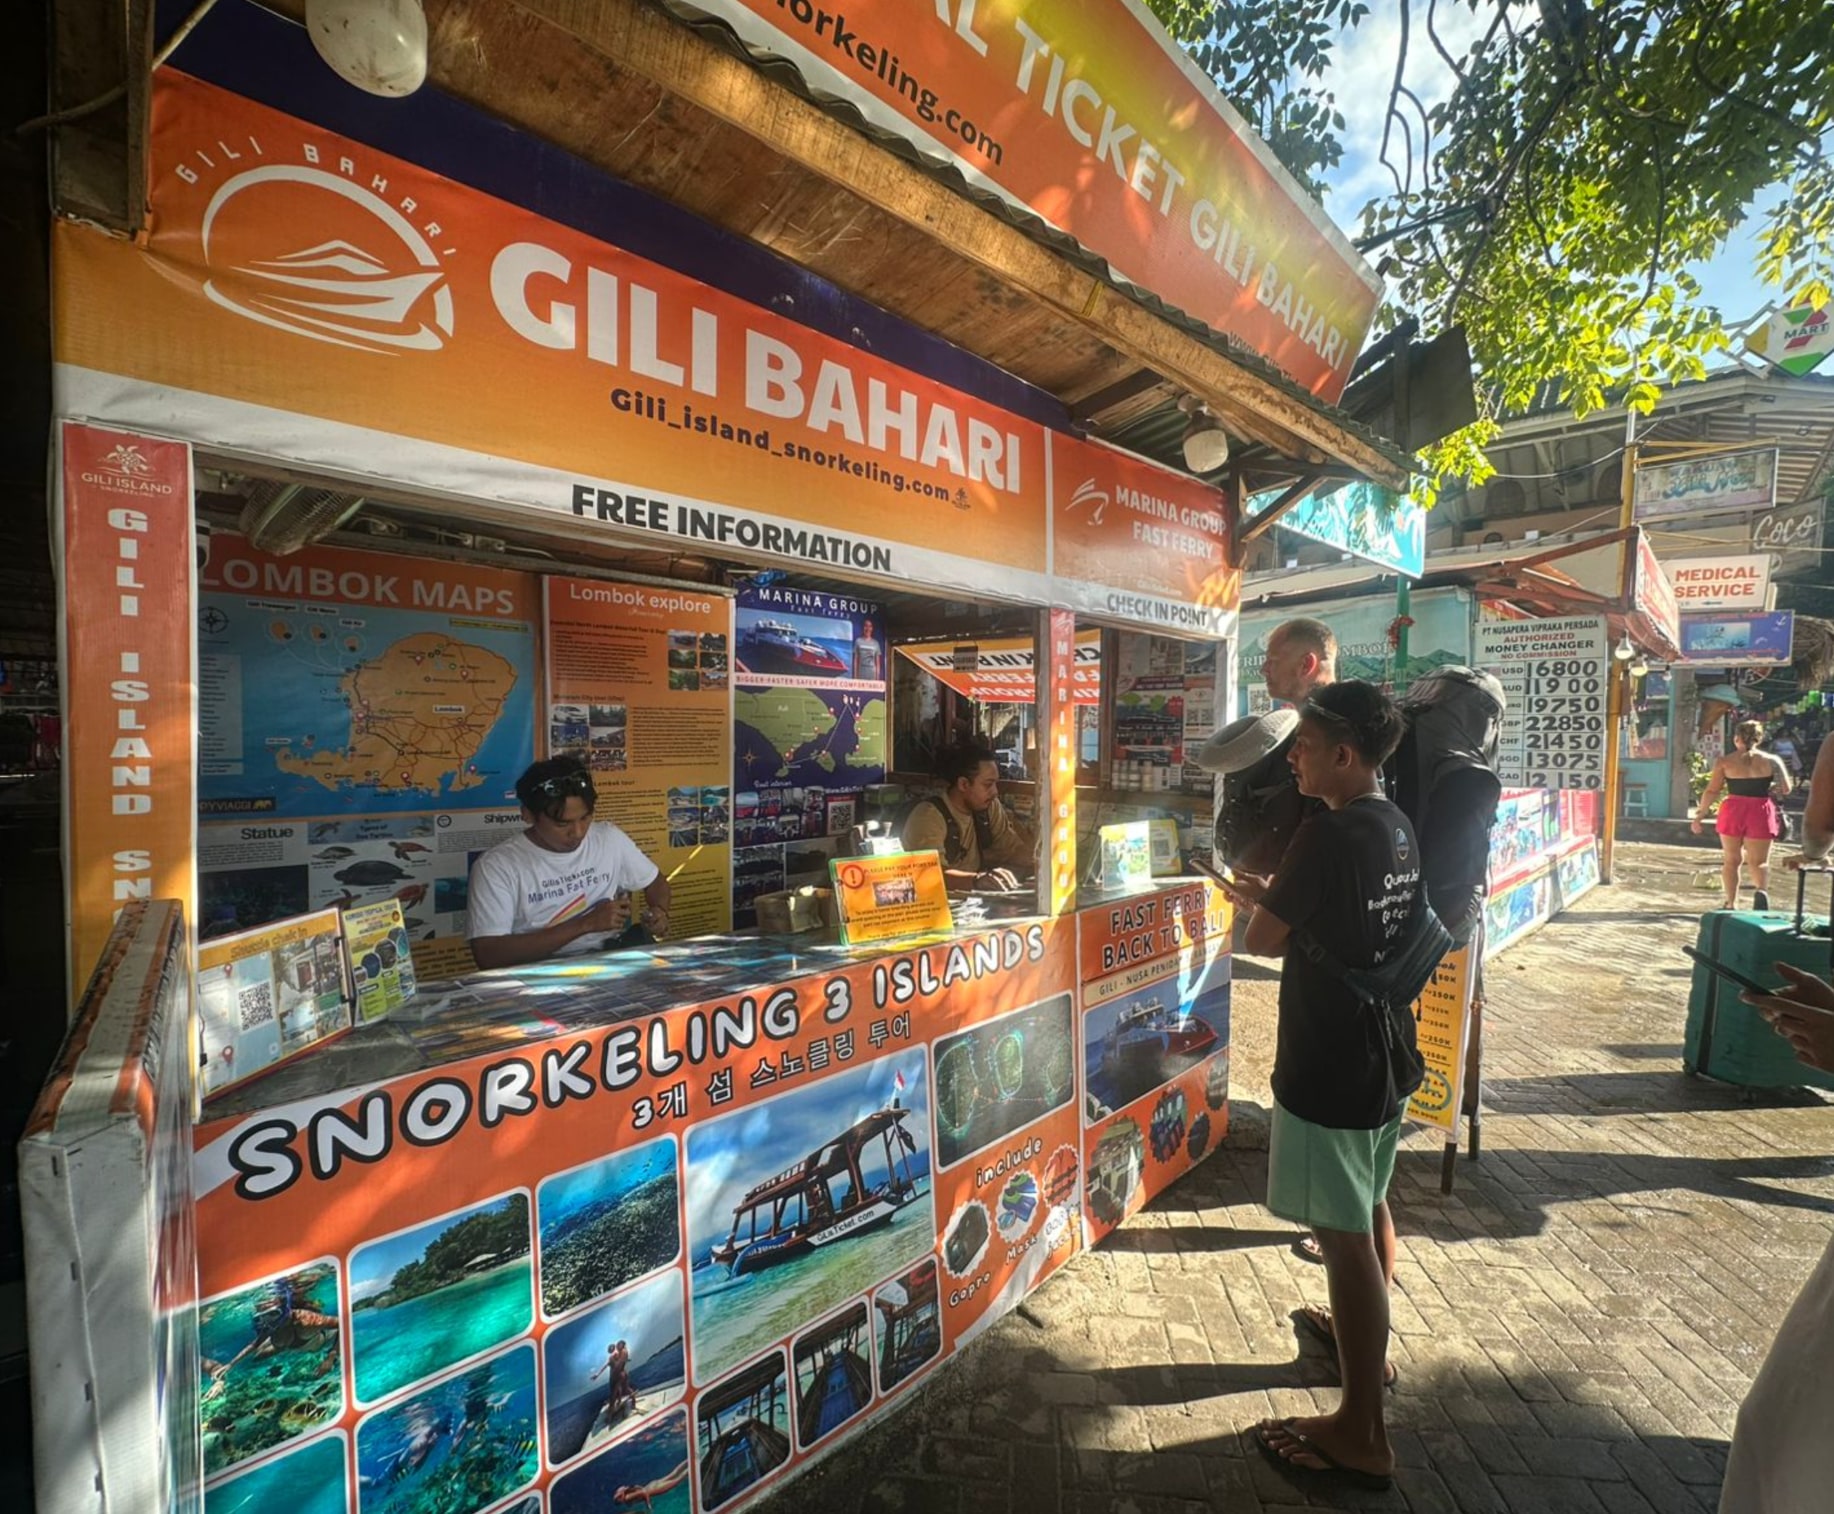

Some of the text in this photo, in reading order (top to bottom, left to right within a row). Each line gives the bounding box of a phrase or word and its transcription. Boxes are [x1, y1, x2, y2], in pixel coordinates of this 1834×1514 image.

[175, 136, 456, 255] GILI BAHARI
[1013, 17, 1185, 217] TICKET
[1190, 200, 1256, 287] GILI
[1256, 267, 1350, 372] BAHARI
[1784, 322, 1830, 339] MART
[490, 242, 1021, 494] GILI BAHARI
[610, 388, 950, 502] Gili_island_snorkeling.com
[81, 472, 173, 495] GILI ISLAND
[1115, 484, 1227, 536] MARINA GROUP
[572, 484, 892, 572] FREE INFORMATION
[1132, 519, 1214, 560] FAST FERRY
[108, 508, 149, 617] GILI
[1675, 566, 1760, 581] MEDICAL
[201, 558, 515, 615] LOMBOK MAPS
[570, 583, 645, 607] Lombok
[649, 594, 711, 614] explore
[760, 588, 879, 615] MARINA GROUP
[1674, 583, 1755, 598] SERVICE
[1107, 592, 1208, 627] CHECK IN POINT
[1482, 627, 1490, 635] PT
[1564, 619, 1599, 630] PERSADA
[1503, 632, 1575, 643] AUTHORIZED
[1485, 640, 1594, 654] MONEY CHANGER
[1518, 650, 1577, 659] COMMISSION
[1527, 660, 1598, 678] 16800
[1501, 684, 1522, 692] AUD
[1527, 696, 1600, 713] 19750
[1056, 639, 1068, 772] MARINA
[109, 652, 153, 816] ISLAND
[1526, 715, 1601, 731] 22850
[1527, 733, 1600, 750] 21450
[1527, 751, 1600, 770] 13075
[241, 826, 294, 842] Statue
[484, 813, 526, 825] Shipwr
[1056, 803, 1068, 894] GROU
[113, 850, 152, 917] SN
[528, 887, 564, 904] Marina
[1110, 887, 1213, 936] FAST FERRY
[1102, 932, 1154, 971] BACK
[1160, 924, 1182, 951] TO
[1189, 911, 1224, 940] BALI
[1099, 983, 1118, 996] GILI
[1125, 972, 1149, 985] NUSA
[226, 925, 1047, 1201] SNORKELING 3 ISLANDS
[632, 1011, 911, 1129] 3개 섬 스노클링 투어
[976, 1136, 1042, 1189] include
[949, 1271, 992, 1308] Gopro
